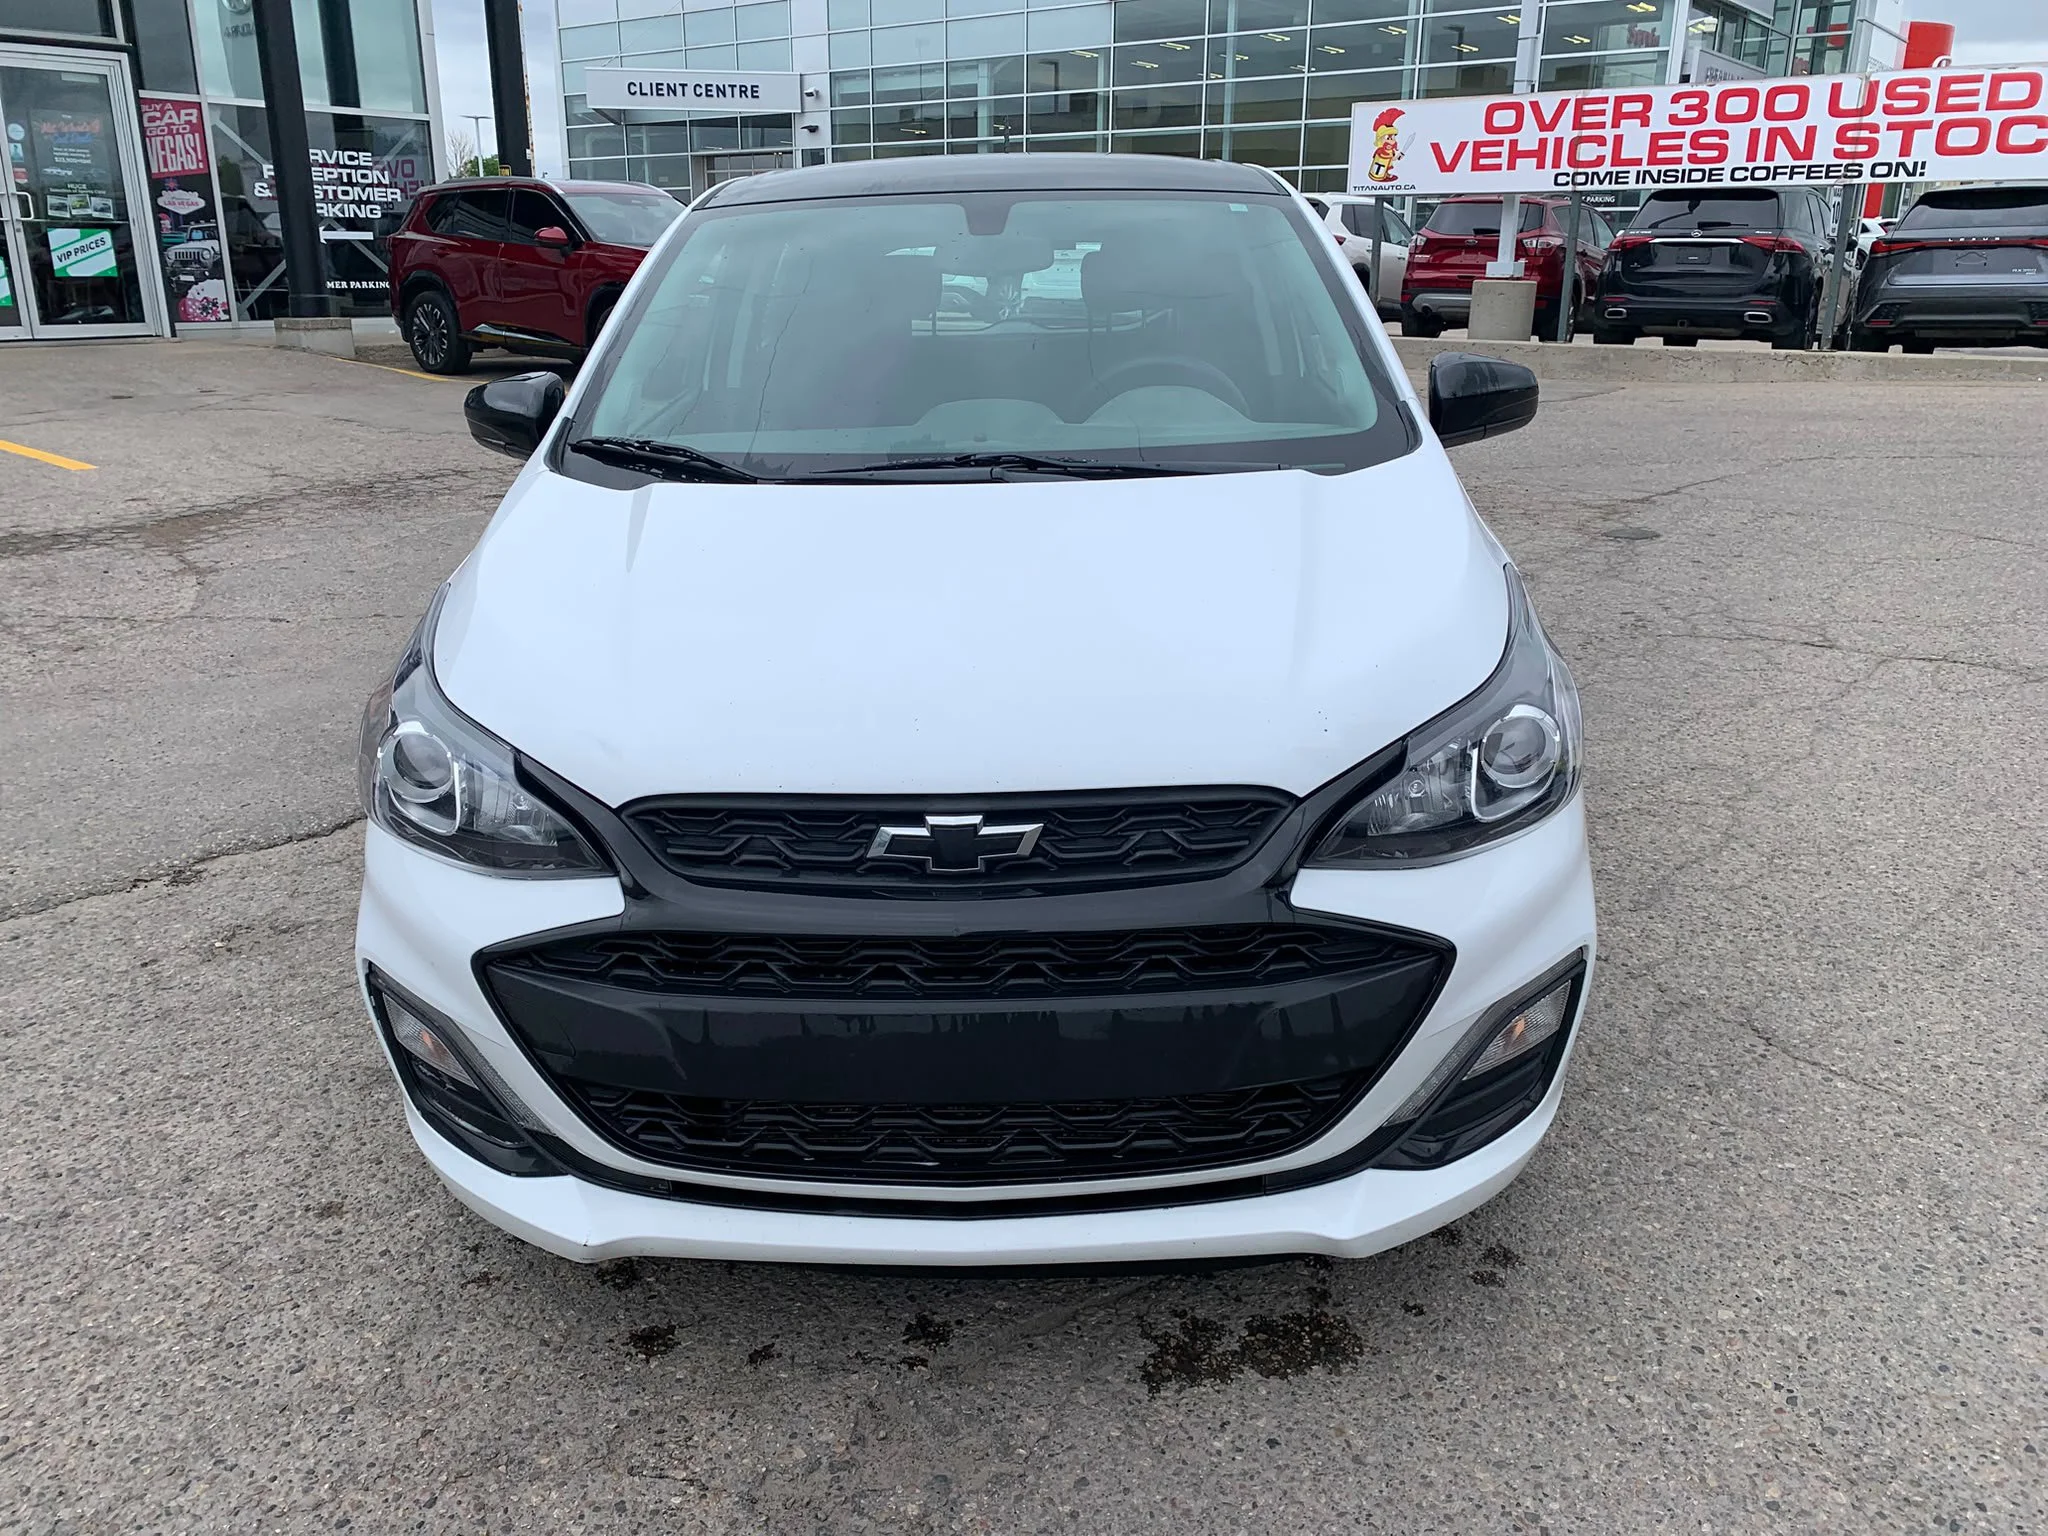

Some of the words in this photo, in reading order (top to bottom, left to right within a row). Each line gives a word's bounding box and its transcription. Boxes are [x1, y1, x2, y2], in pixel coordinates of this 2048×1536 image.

[627, 81, 689, 97] CLIENT
[693, 83, 760, 99] CENTRE
[164, 102, 173, 110] A
[1483, 93, 1654, 135] OVER
[1668, 85, 1811, 128] 300
[1827, 71, 2043, 119] USED
[142, 108, 198, 127] CAR
[146, 126, 168, 136] GO
[170, 124, 190, 134] TO
[146, 132, 204, 173] VEGAS!
[1430, 129, 1730, 174] VEHICLES
[1745, 125, 1818, 163] IN
[1832, 114, 2048, 160] STOC
[308, 148, 373, 167] RVICE
[1553, 170, 1631, 187] COME
[1634, 167, 1725, 186] INSIDE
[1729, 161, 1864, 182] COFFEES
[1869, 160, 1928, 178] ON!
[253, 181, 273, 198] &
[313, 184, 402, 203] STOMER
[1352, 184, 1416, 192] TITANAUTO.CA
[315, 202, 382, 219] RKING
[56, 250, 73, 263] VIP
[73, 236, 107, 257] PRICES
[326, 280, 348, 289] MER
